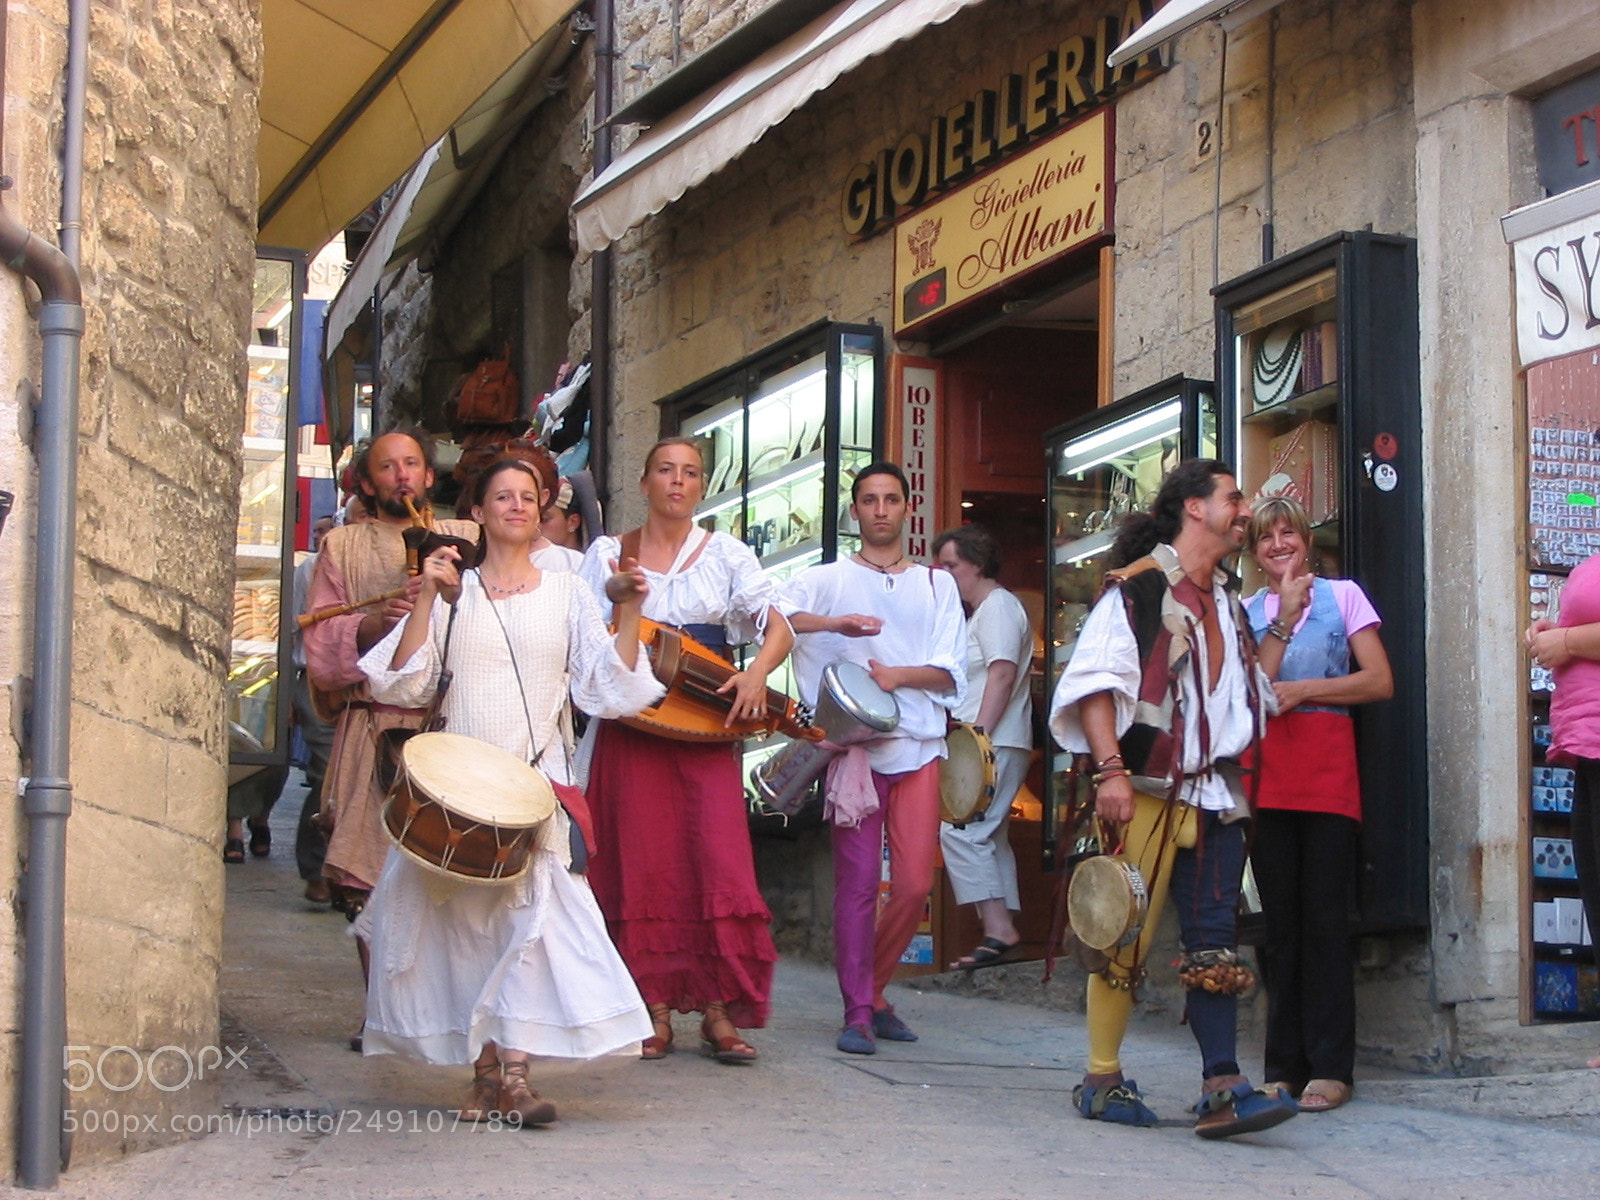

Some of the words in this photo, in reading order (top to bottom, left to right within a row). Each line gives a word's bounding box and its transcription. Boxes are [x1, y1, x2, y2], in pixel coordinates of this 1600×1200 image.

[841, 0, 1150, 237] GIOIELLERIA
[1562, 104, 1600, 166] T
[957, 183, 1101, 290] Albani
[970, 150, 1086, 231] Gioielleria
[907, 385, 931, 564] ЮВЕЛИРНЫ
